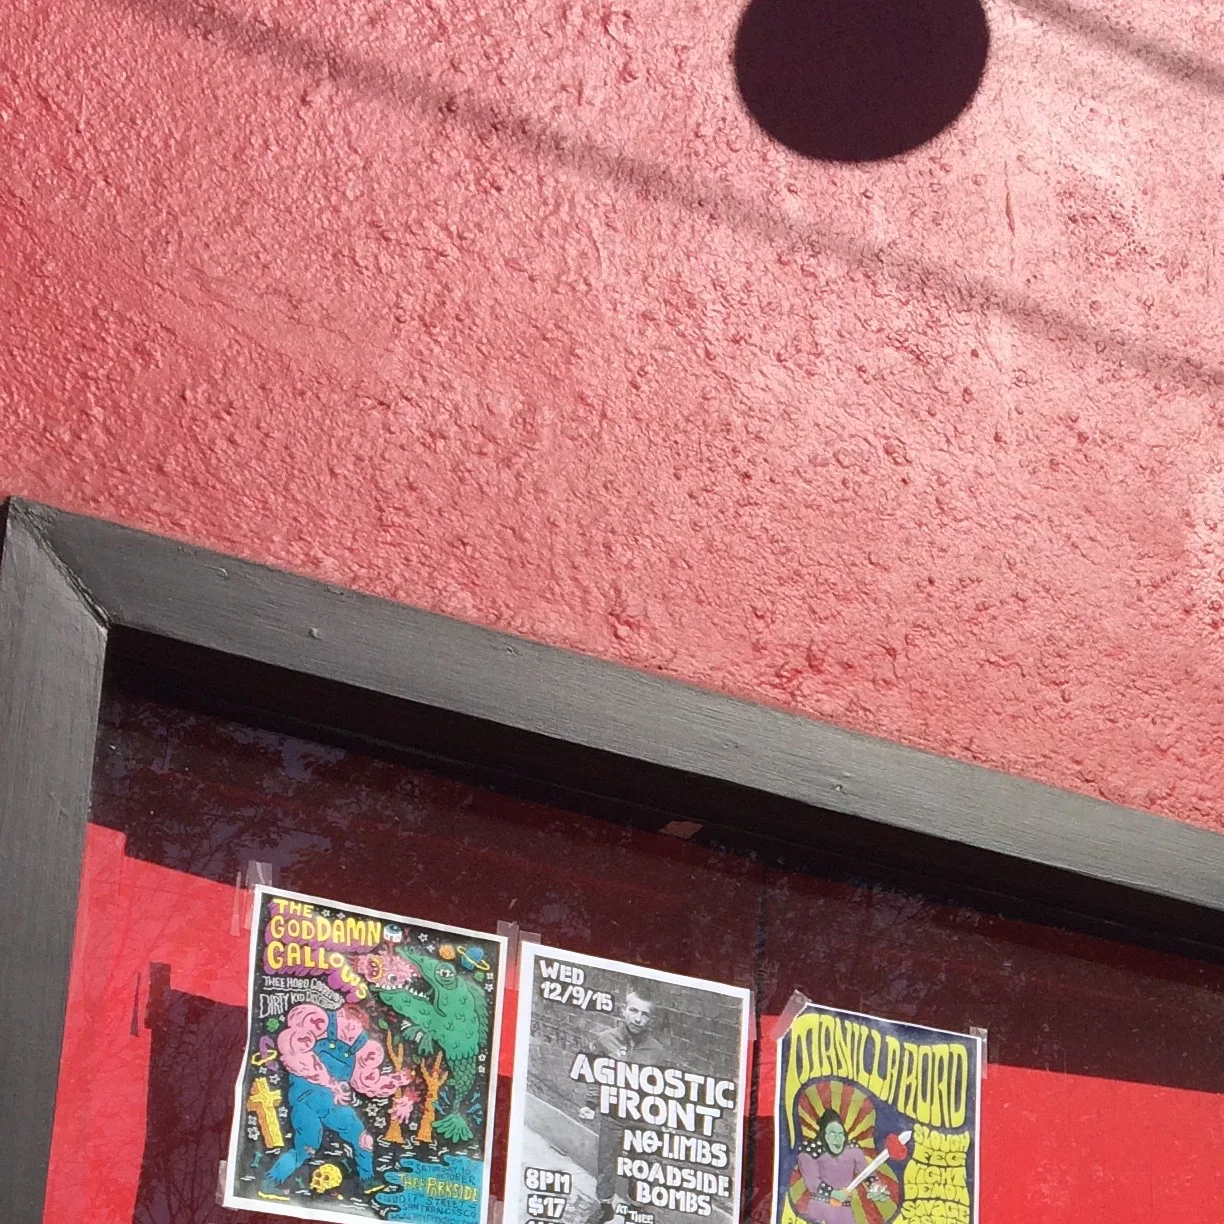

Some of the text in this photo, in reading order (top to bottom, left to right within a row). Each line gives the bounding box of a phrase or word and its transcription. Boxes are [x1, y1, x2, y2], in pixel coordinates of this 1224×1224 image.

[272, 898, 314, 918] THE
[270, 915, 382, 947] GODDAMN
[266, 941, 368, 999] GALLOWS
[538, 959, 585, 986] WED
[540, 983, 614, 1013] 12/9/15
[570, 1054, 735, 1109] AGNOSTIC
[599, 1085, 721, 1137] FRONT
[524, 1167, 571, 1194] 8PM
[616, 1156, 731, 1197] ROADSIDE
[527, 1196, 567, 1217] $17
[615, 1203, 629, 1216] AT
[636, 1180, 712, 1217] BOMBS
[629, 1210, 654, 1224] THEE
